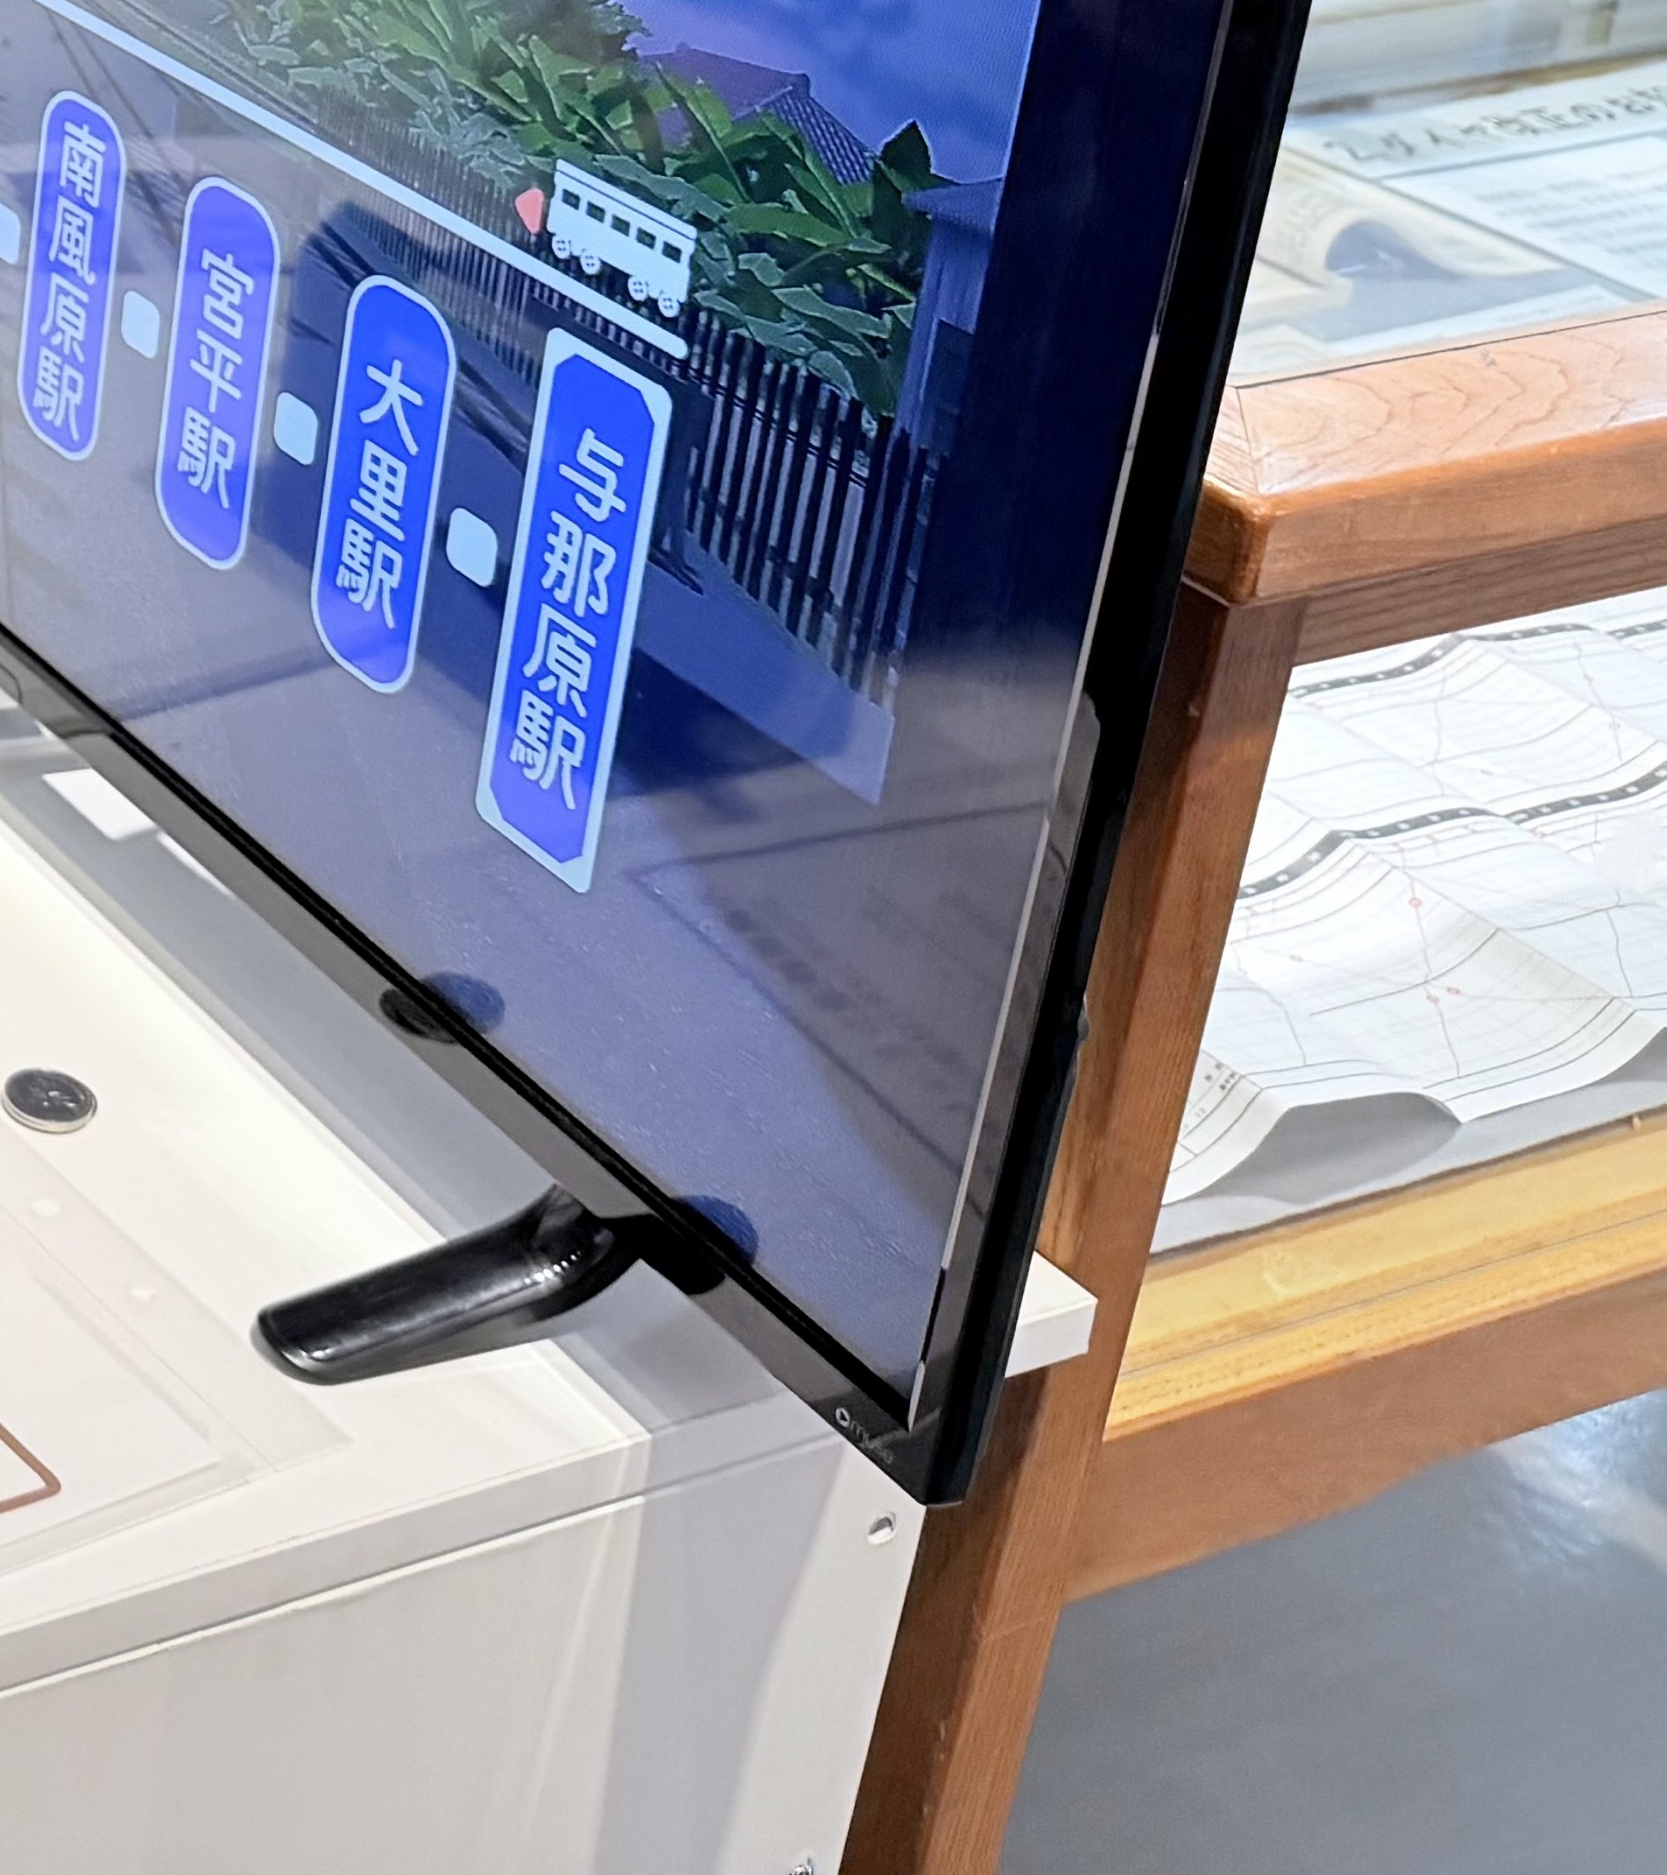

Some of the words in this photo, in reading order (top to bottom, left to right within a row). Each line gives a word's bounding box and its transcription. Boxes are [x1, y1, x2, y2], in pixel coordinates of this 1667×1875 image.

[32, 119, 108, 442] 南風原駅
[178, 248, 255, 510] 宮平駅
[336, 357, 425, 629] 大里駅
[509, 429, 626, 810] 与那原駅
